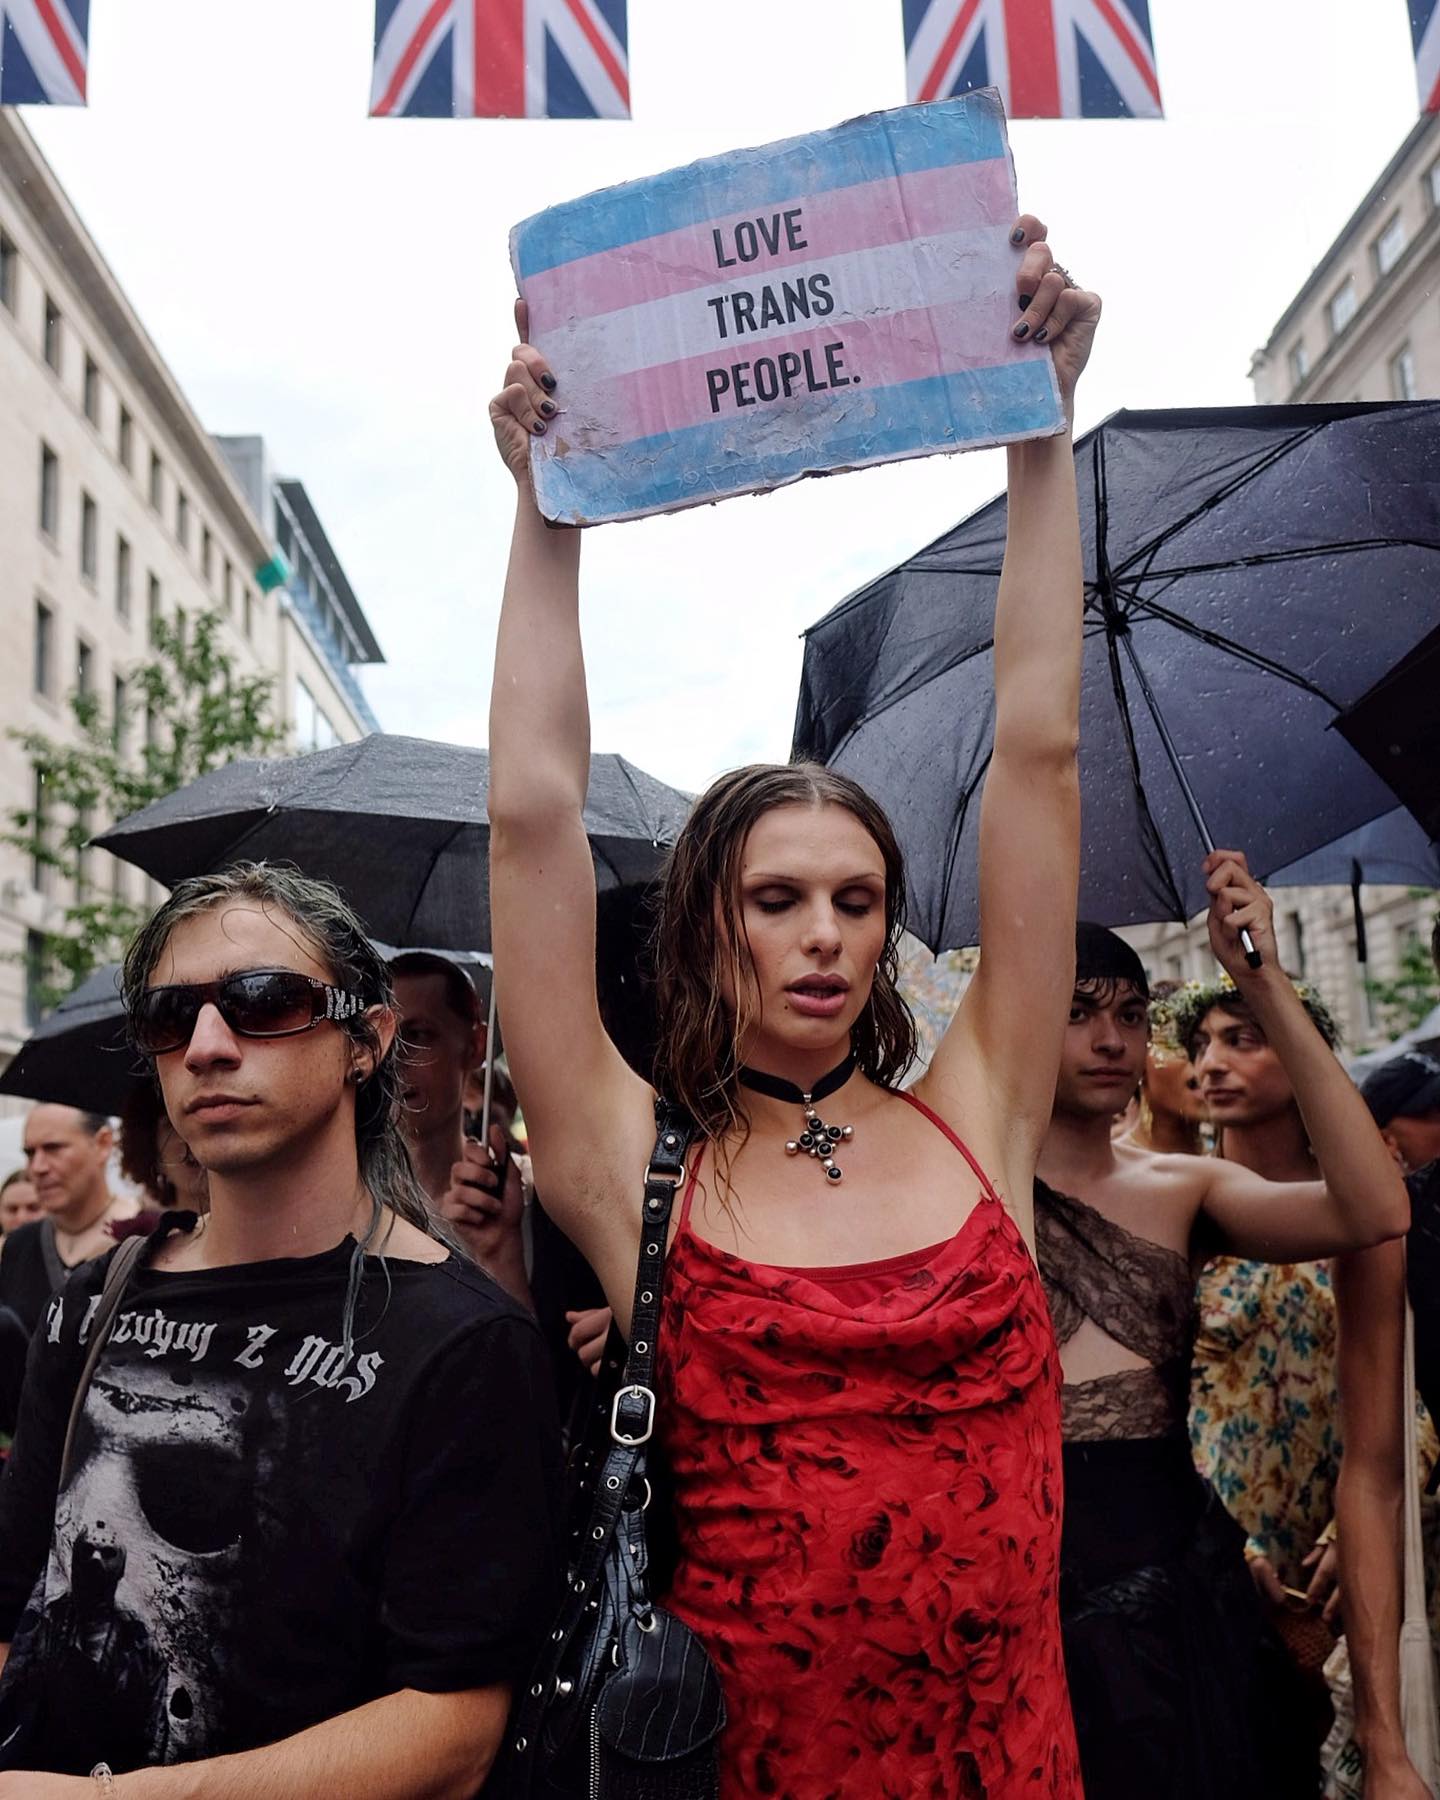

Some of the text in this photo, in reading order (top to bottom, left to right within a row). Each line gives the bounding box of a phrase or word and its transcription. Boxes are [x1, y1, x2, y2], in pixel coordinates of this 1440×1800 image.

[713, 208, 808, 268] LOVE
[707, 273, 835, 339] TRANS
[706, 342, 861, 413] PEOPLE.
